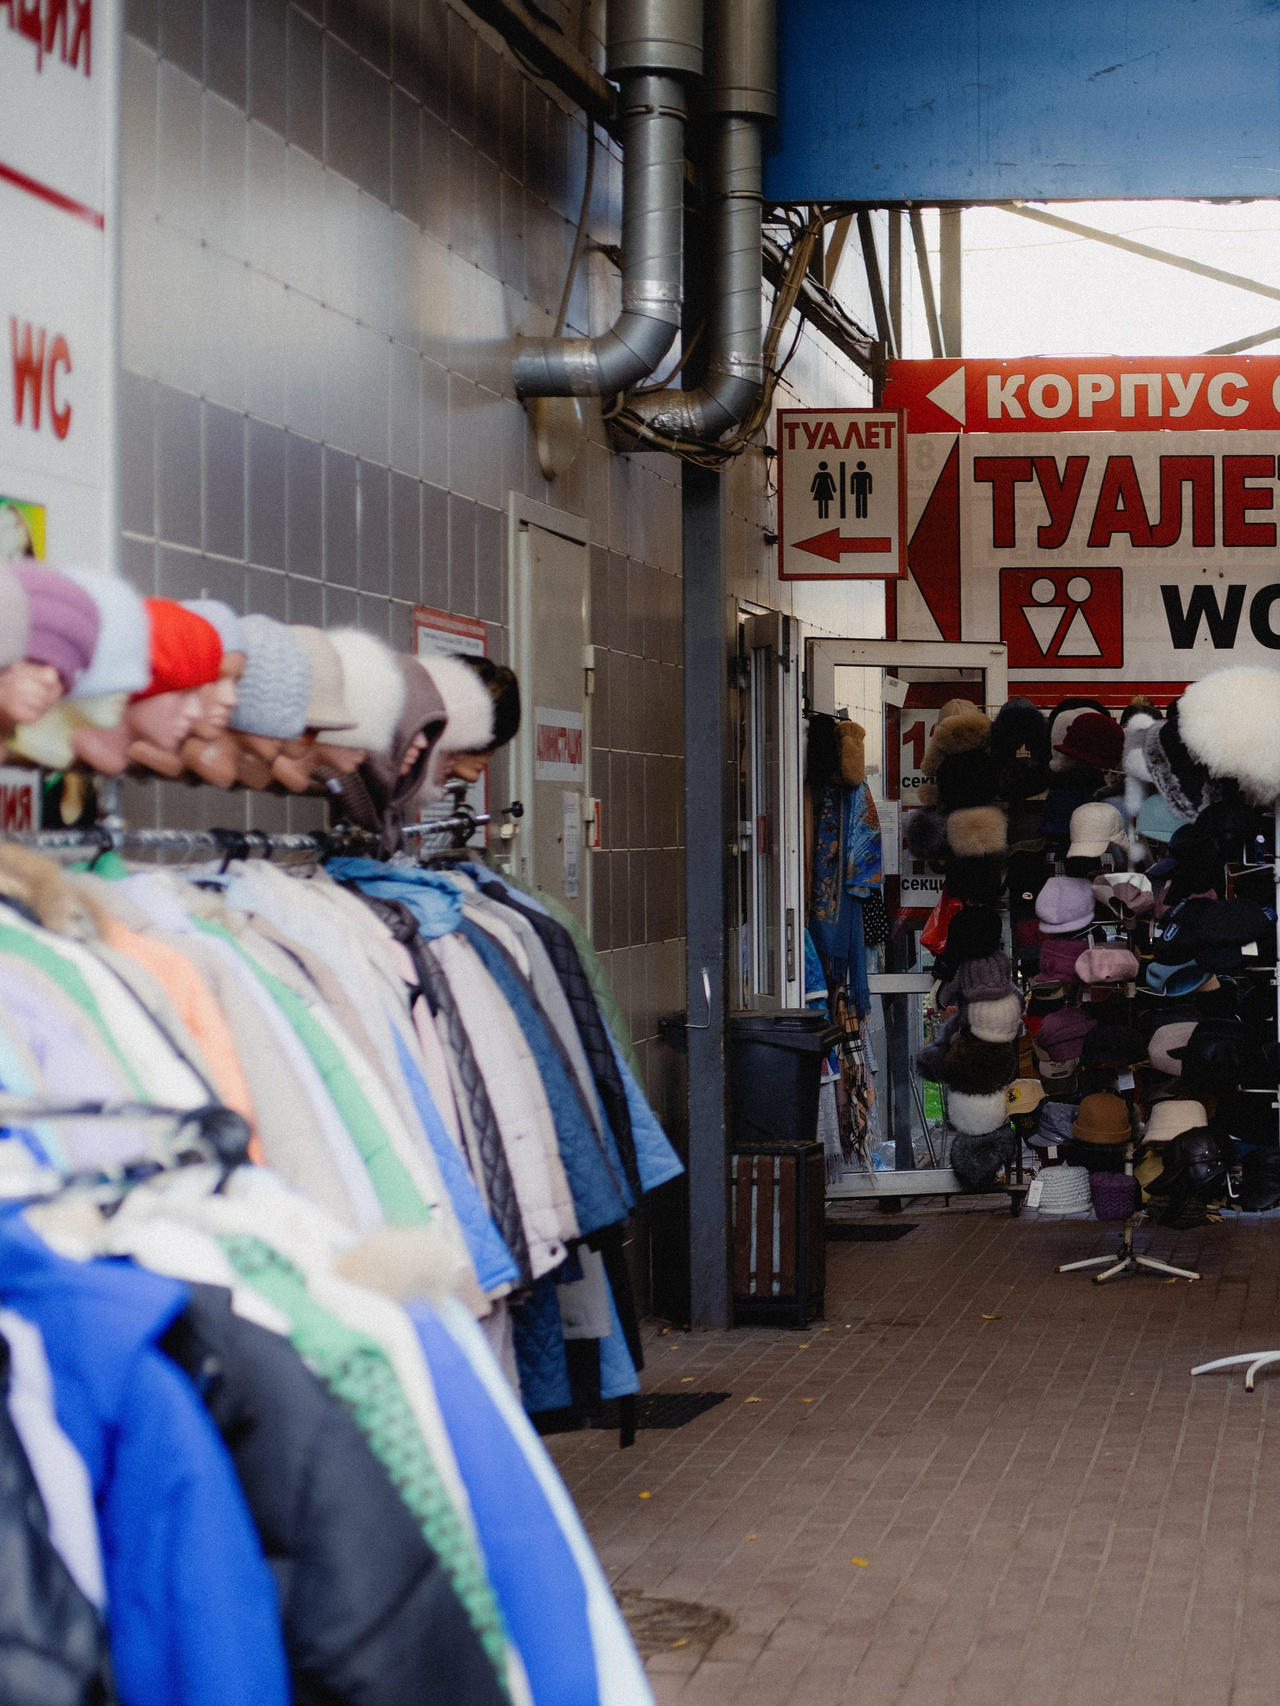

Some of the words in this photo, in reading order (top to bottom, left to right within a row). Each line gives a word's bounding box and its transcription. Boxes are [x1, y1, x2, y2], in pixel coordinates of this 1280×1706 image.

[9, 314, 72, 440] WC
[987, 372, 1250, 418] КОРПУС
[784, 422, 896, 449] ТУАЛЕТ
